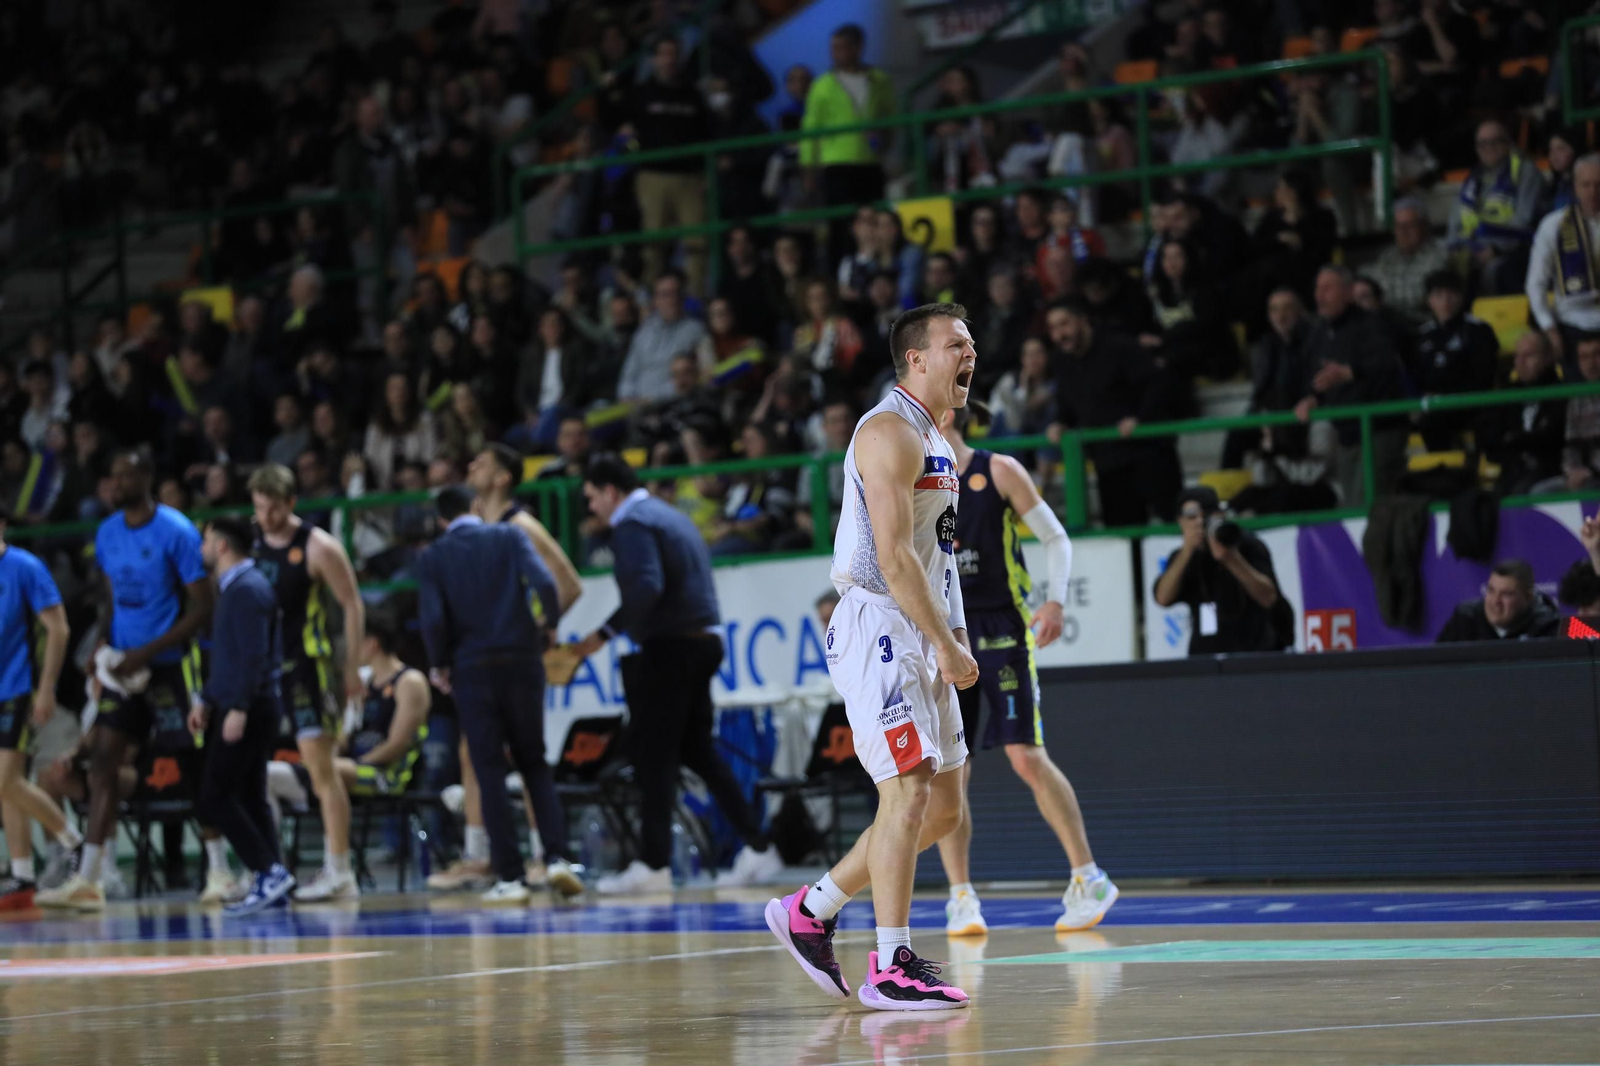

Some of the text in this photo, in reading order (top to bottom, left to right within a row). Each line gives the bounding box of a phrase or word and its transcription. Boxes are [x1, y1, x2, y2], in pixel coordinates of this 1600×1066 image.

[563, 615, 832, 708] ABNCA
[878, 634, 894, 663] 3
[1005, 694, 1018, 720] 1
